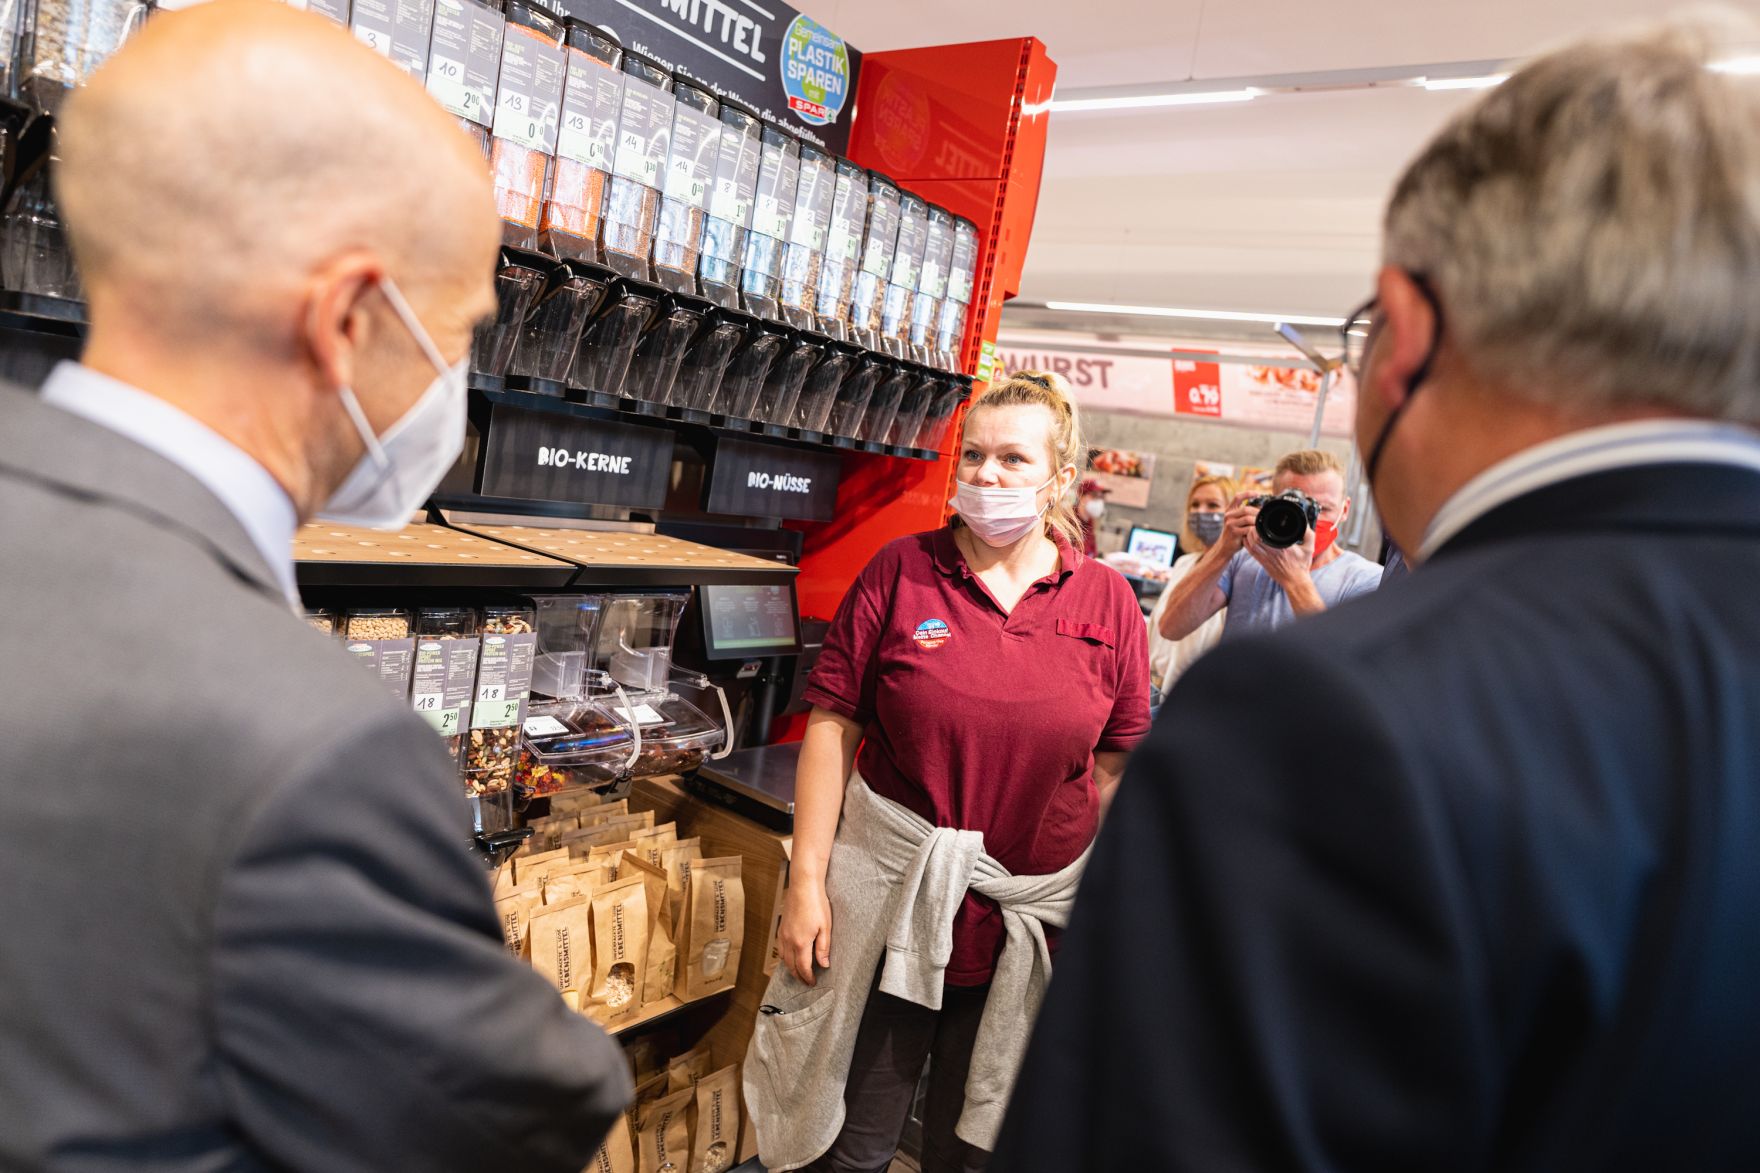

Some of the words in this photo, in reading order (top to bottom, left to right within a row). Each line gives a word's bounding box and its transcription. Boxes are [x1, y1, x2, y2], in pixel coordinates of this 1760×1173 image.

[367, 32, 377, 49] 3
[788, 37, 845, 76] PLASTIK
[438, 62, 457, 77] 10
[787, 60, 842, 96] SPAREN
[504, 94, 522, 111] 13
[795, 100, 826, 118] SPAR
[568, 114, 584, 130] 13
[624, 136, 637, 151] 14
[675, 161, 688, 174] 14
[1000, 353, 1113, 389] WURST
[538, 446, 632, 474] BIO-KERNE
[747, 471, 811, 493] BIO-NÜSSE
[482, 688, 499, 700] 18
[418, 697, 435, 710] 18
[616, 903, 624, 960] LEBENSMITTEL
[562, 927, 571, 988] LEBENSMITTEL
